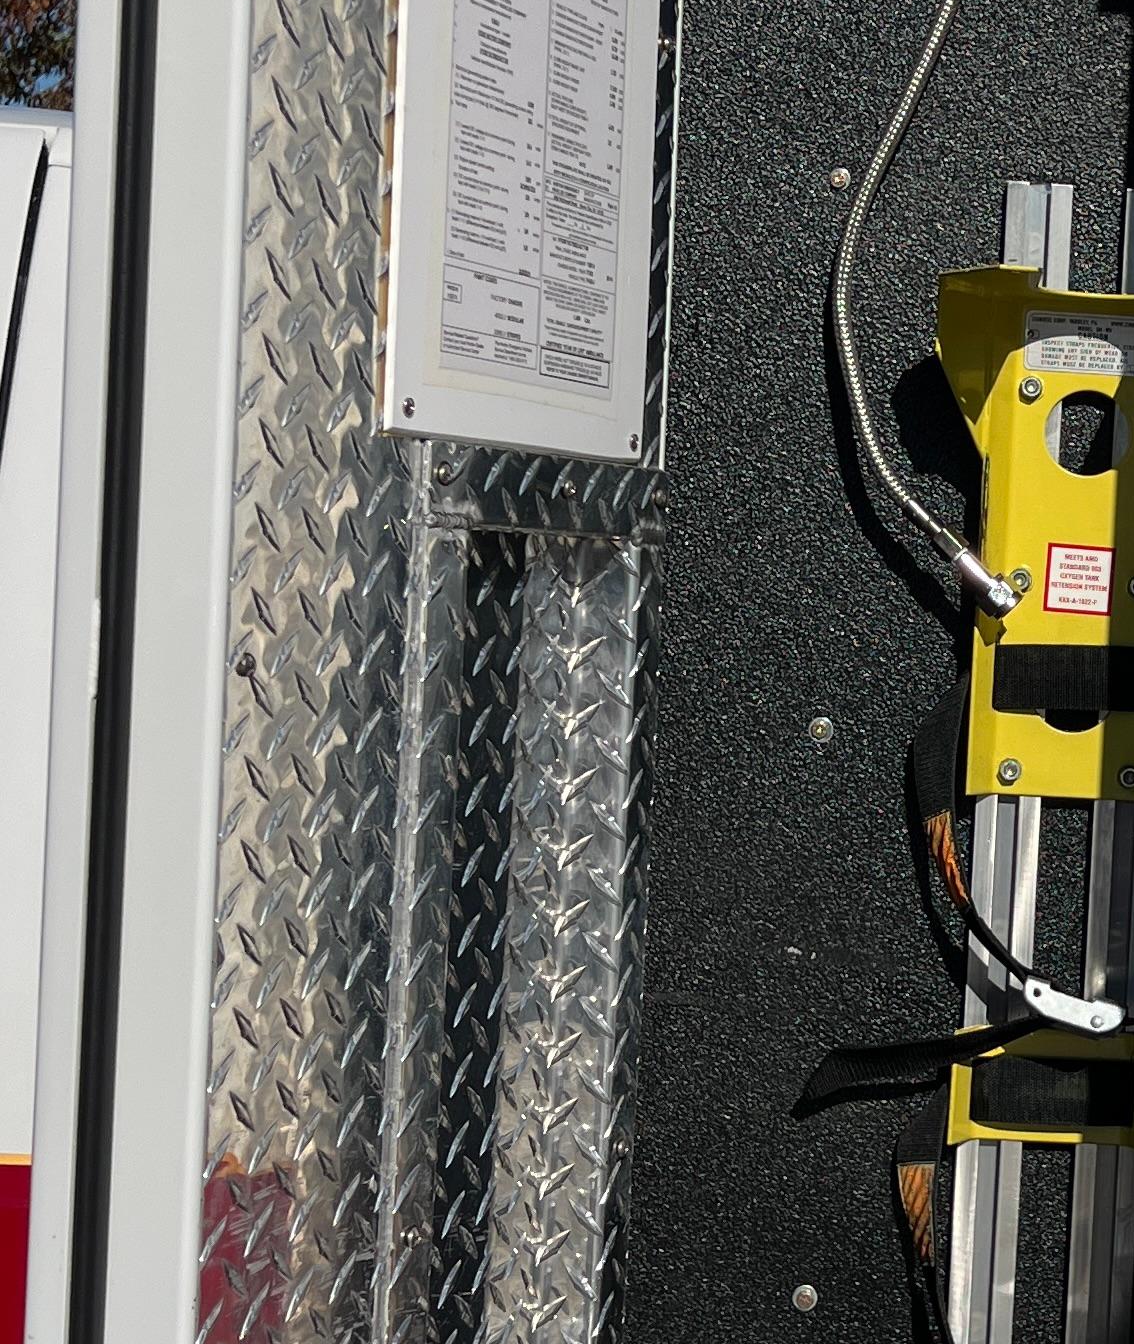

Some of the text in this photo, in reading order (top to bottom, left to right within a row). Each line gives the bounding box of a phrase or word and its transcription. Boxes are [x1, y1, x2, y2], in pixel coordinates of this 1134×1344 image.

[1041, 346, 1065, 354] SHOWING
[1064, 553, 1084, 561] MEETS
[1059, 562, 1090, 571] STANDARD
[1084, 584, 1108, 592] SYSTEM
